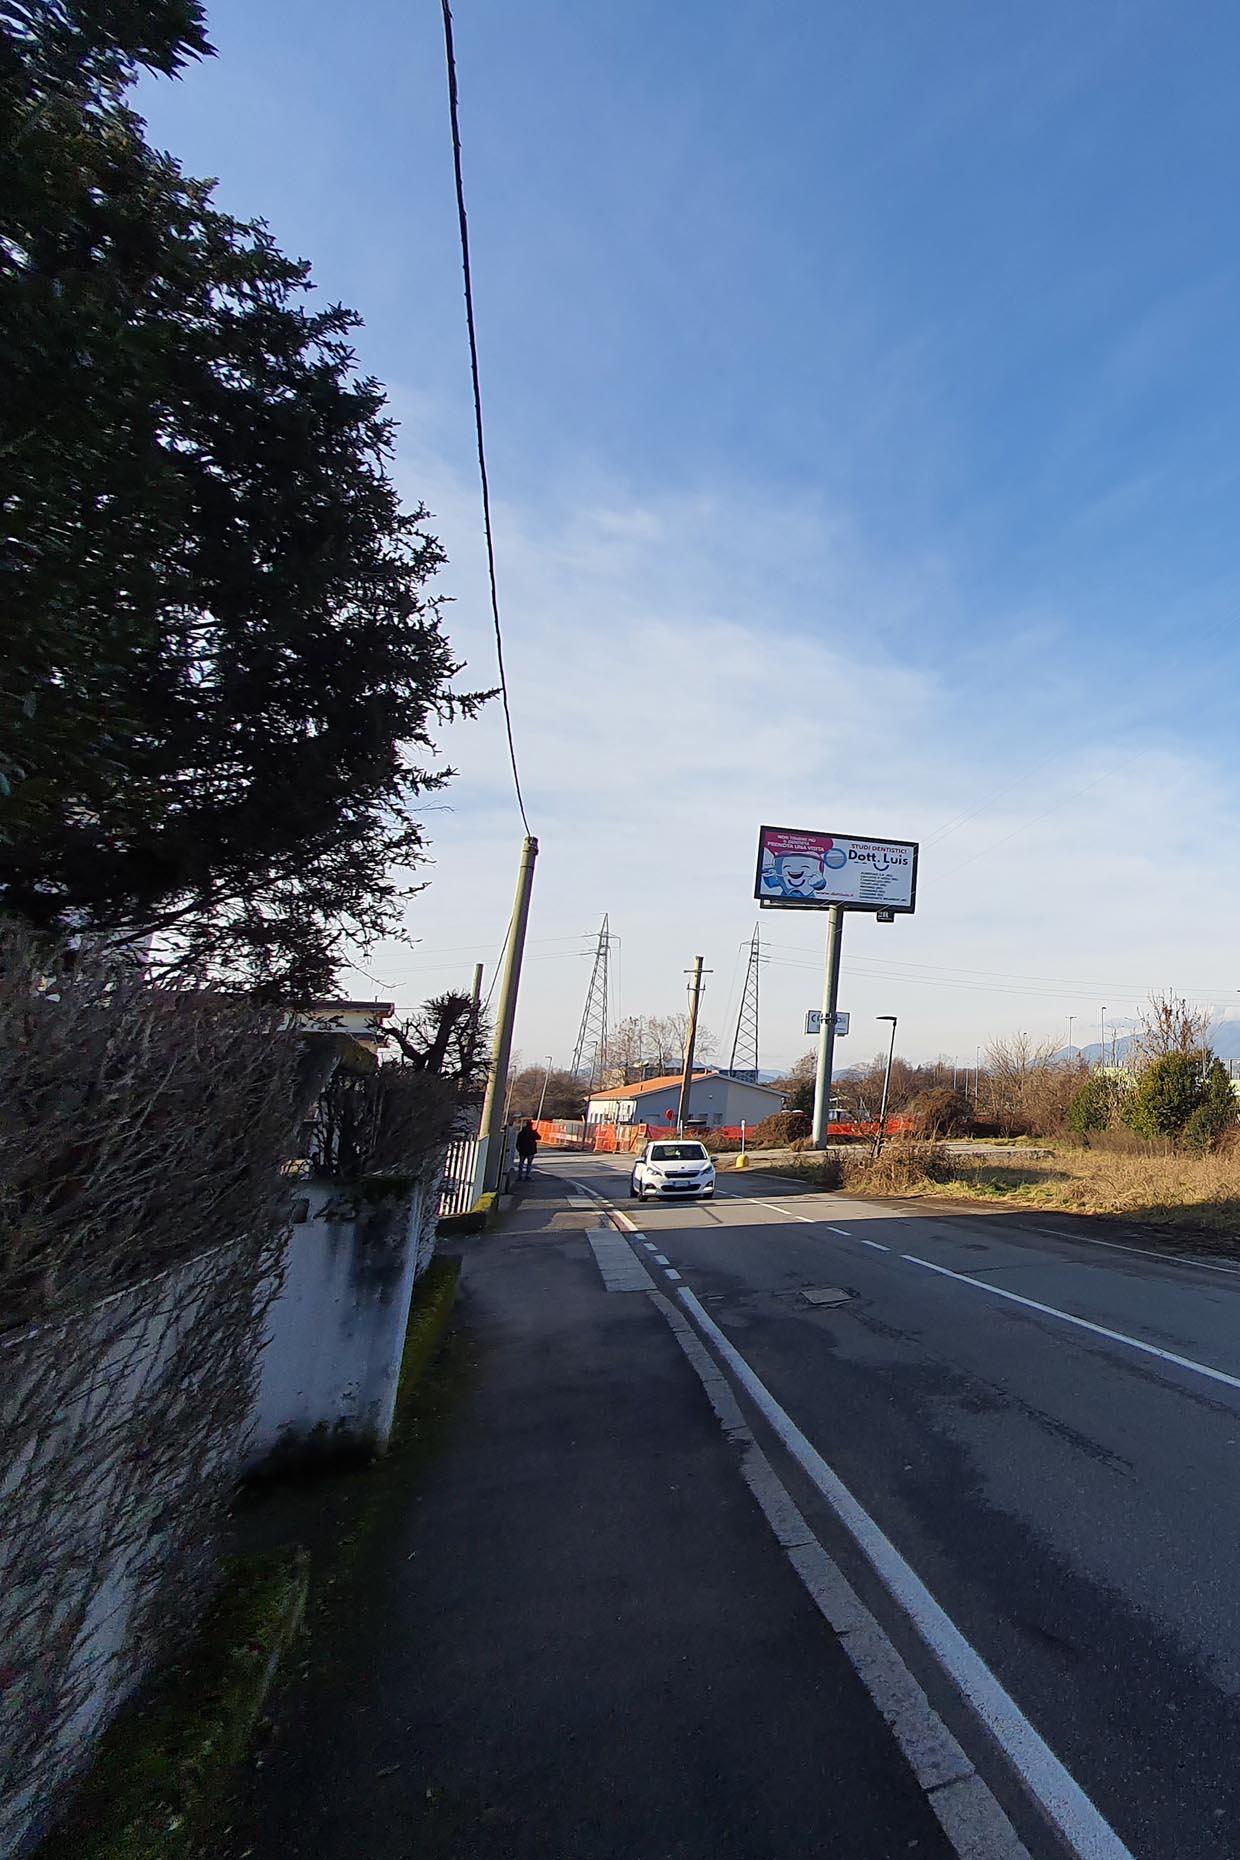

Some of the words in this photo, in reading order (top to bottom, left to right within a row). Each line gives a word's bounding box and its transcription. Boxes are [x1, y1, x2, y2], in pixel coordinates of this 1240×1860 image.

[852, 843, 871, 851] STUDI
[872, 846, 907, 854] DENTISTICI
[848, 849, 881, 863] Dott.
[883, 853, 909, 866] Luis
